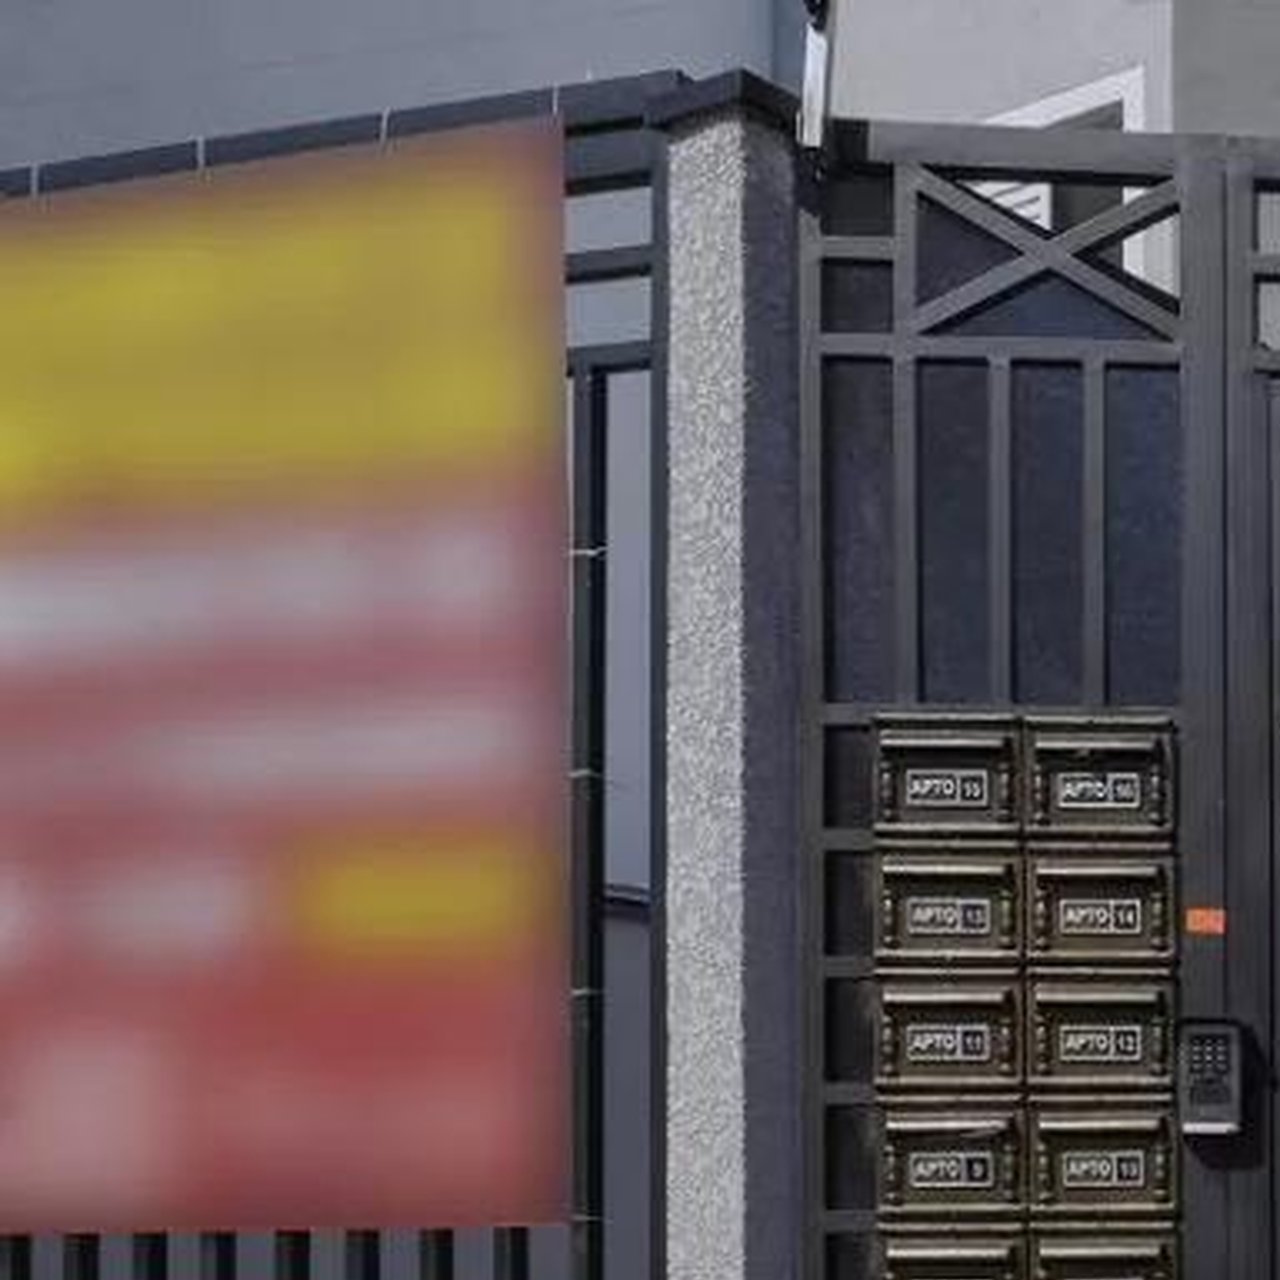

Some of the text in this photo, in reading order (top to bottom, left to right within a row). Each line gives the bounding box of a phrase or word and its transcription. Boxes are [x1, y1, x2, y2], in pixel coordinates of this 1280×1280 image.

[910, 778, 955, 796] APTO
[1063, 781, 1105, 799] APTO
[911, 906, 957, 925] APTO
[1065, 906, 1108, 924] APTO
[911, 1032, 956, 1050] APTO
[1065, 1032, 1108, 1050] APTO
[914, 1160, 959, 1178] APTO
[1067, 1159, 1111, 1177] APTO
